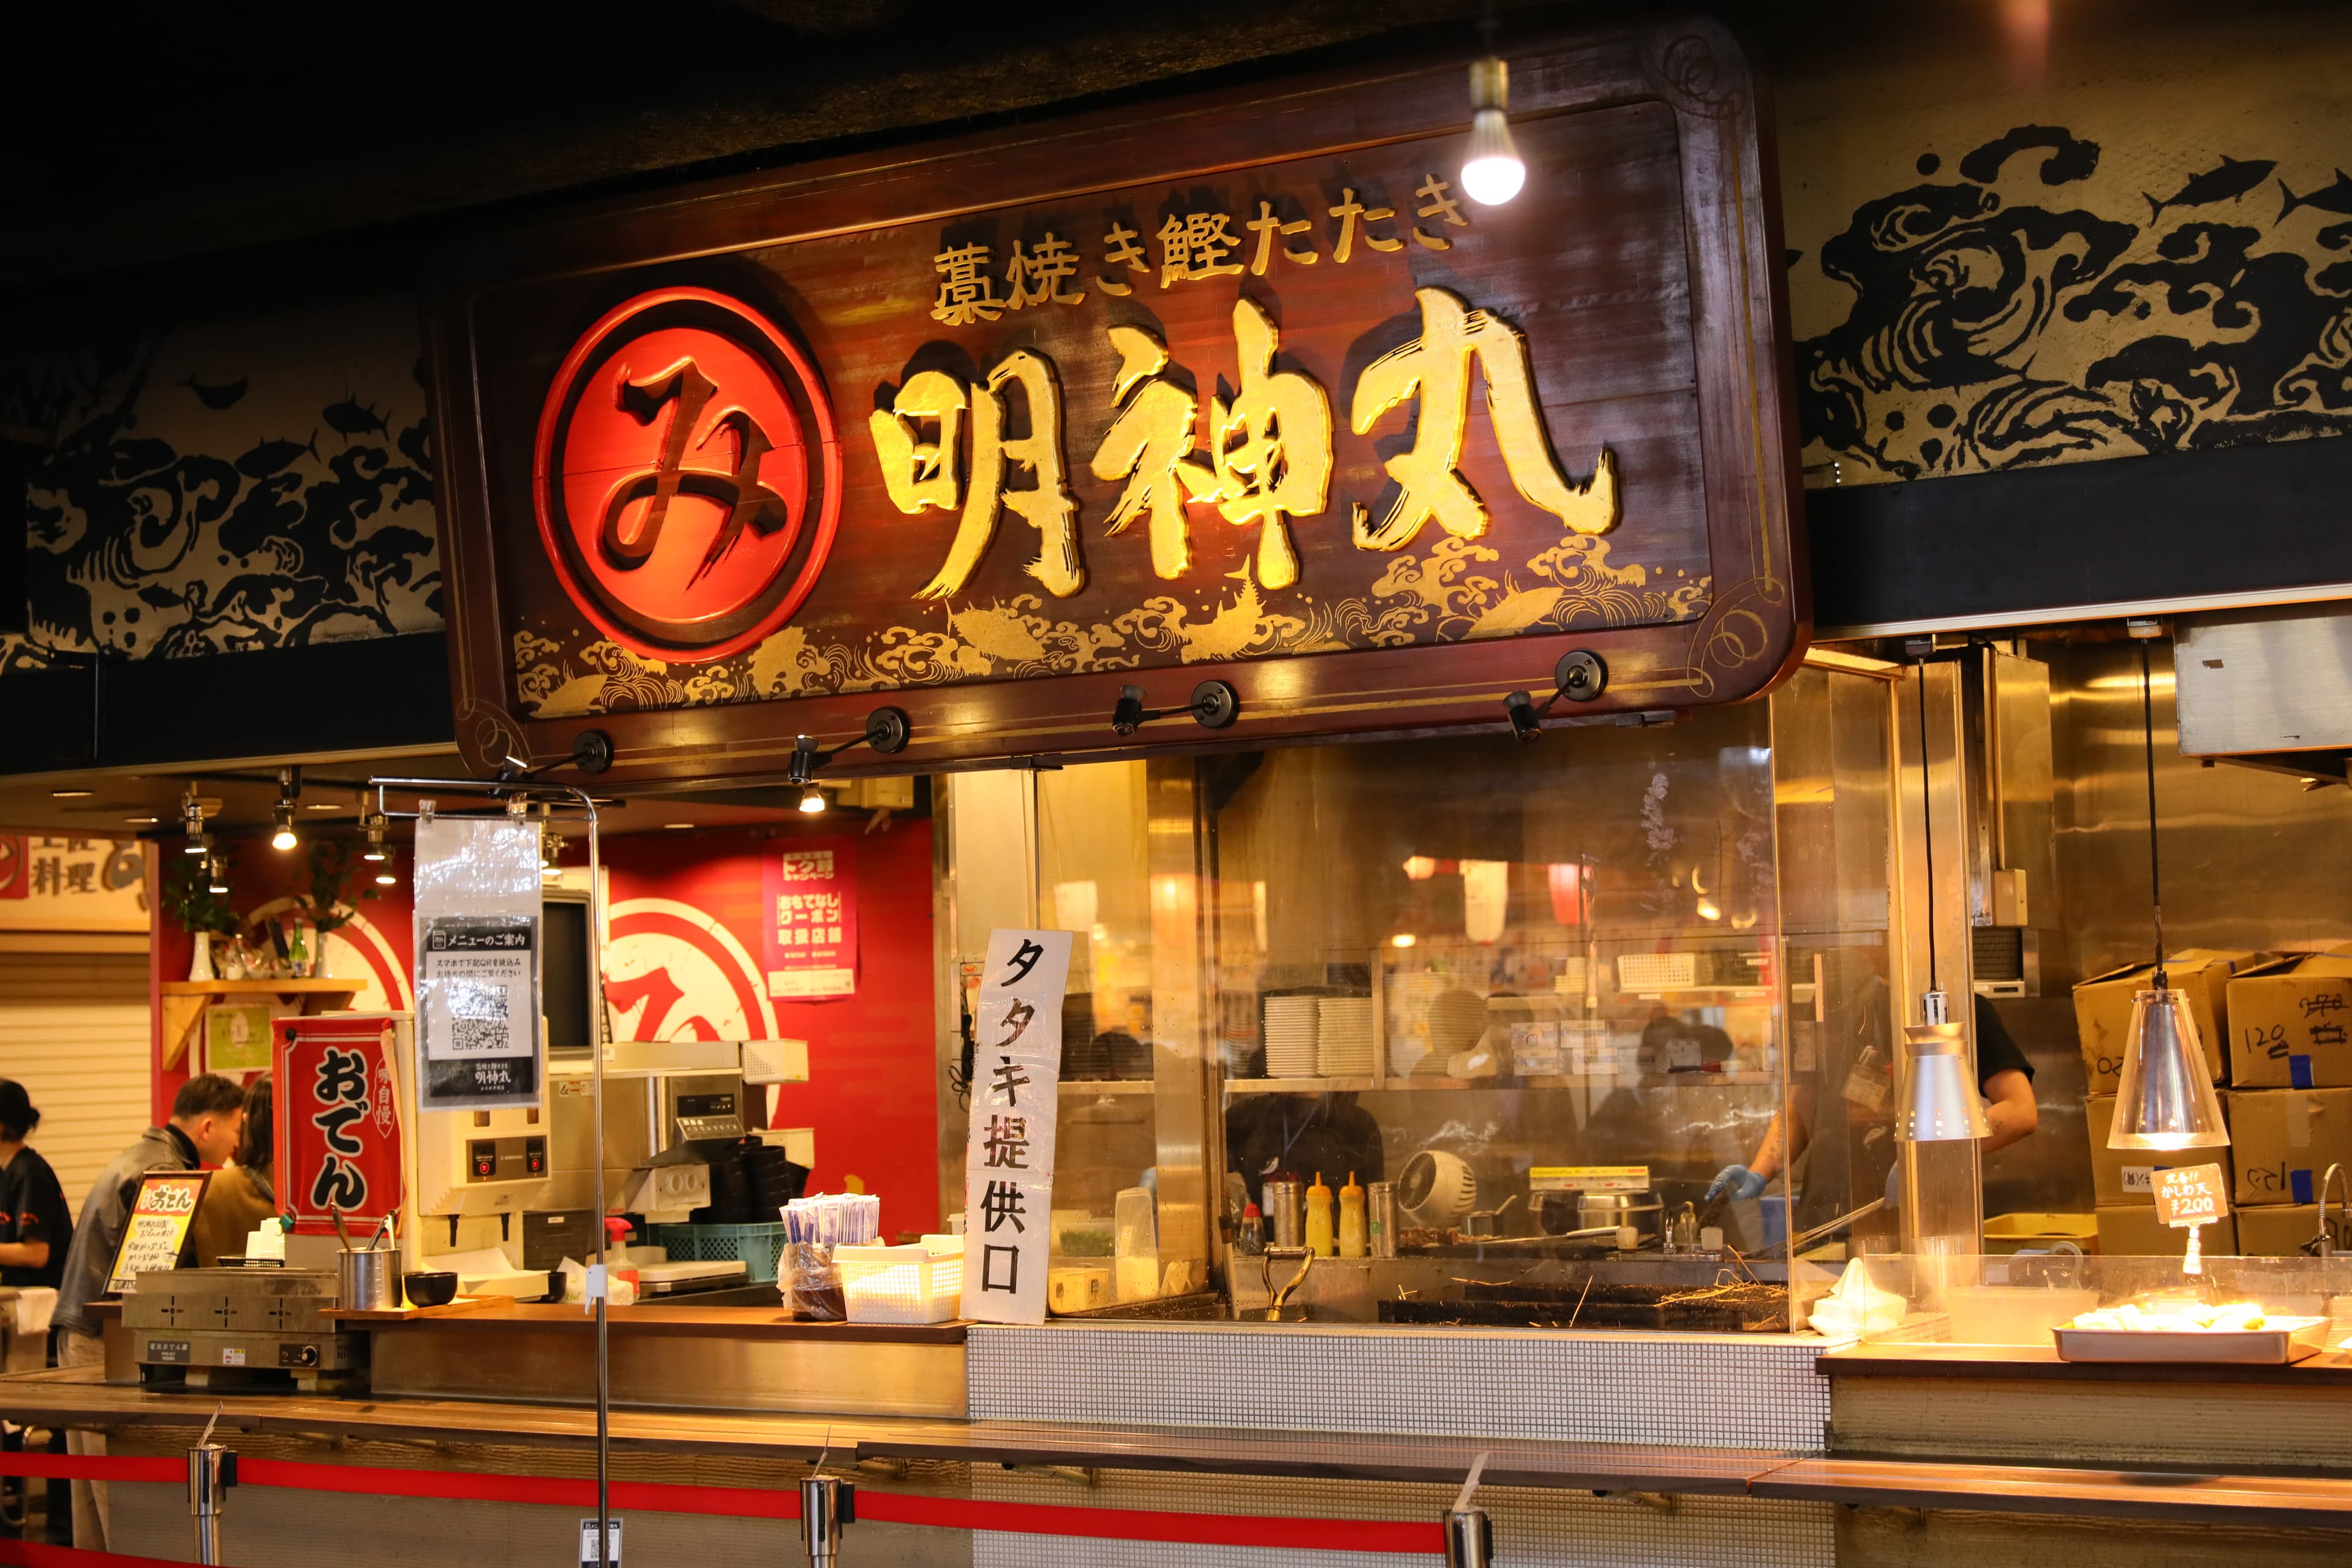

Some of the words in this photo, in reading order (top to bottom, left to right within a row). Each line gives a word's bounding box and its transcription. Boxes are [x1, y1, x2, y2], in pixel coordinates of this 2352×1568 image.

[930, 173, 1468, 326] 藁焼き鰹たたき
[869, 285, 1621, 600] 明神丸
[596, 355, 788, 592] み
[31, 857, 97, 896] 料理
[779, 892, 839, 910] おもてなし
[780, 908, 839, 925] クーポン
[448, 933, 525, 946] メニューのご案内
[475, 1069, 511, 1085] 明神丸
[375, 1068, 392, 1126] 味自慢
[981, 938, 1044, 1294] タタキ提供口
[311, 1046, 370, 1212] おでん
[2161, 1182, 2213, 1198] かしわ天
[2171, 1197, 2214, 1216] ¥200
